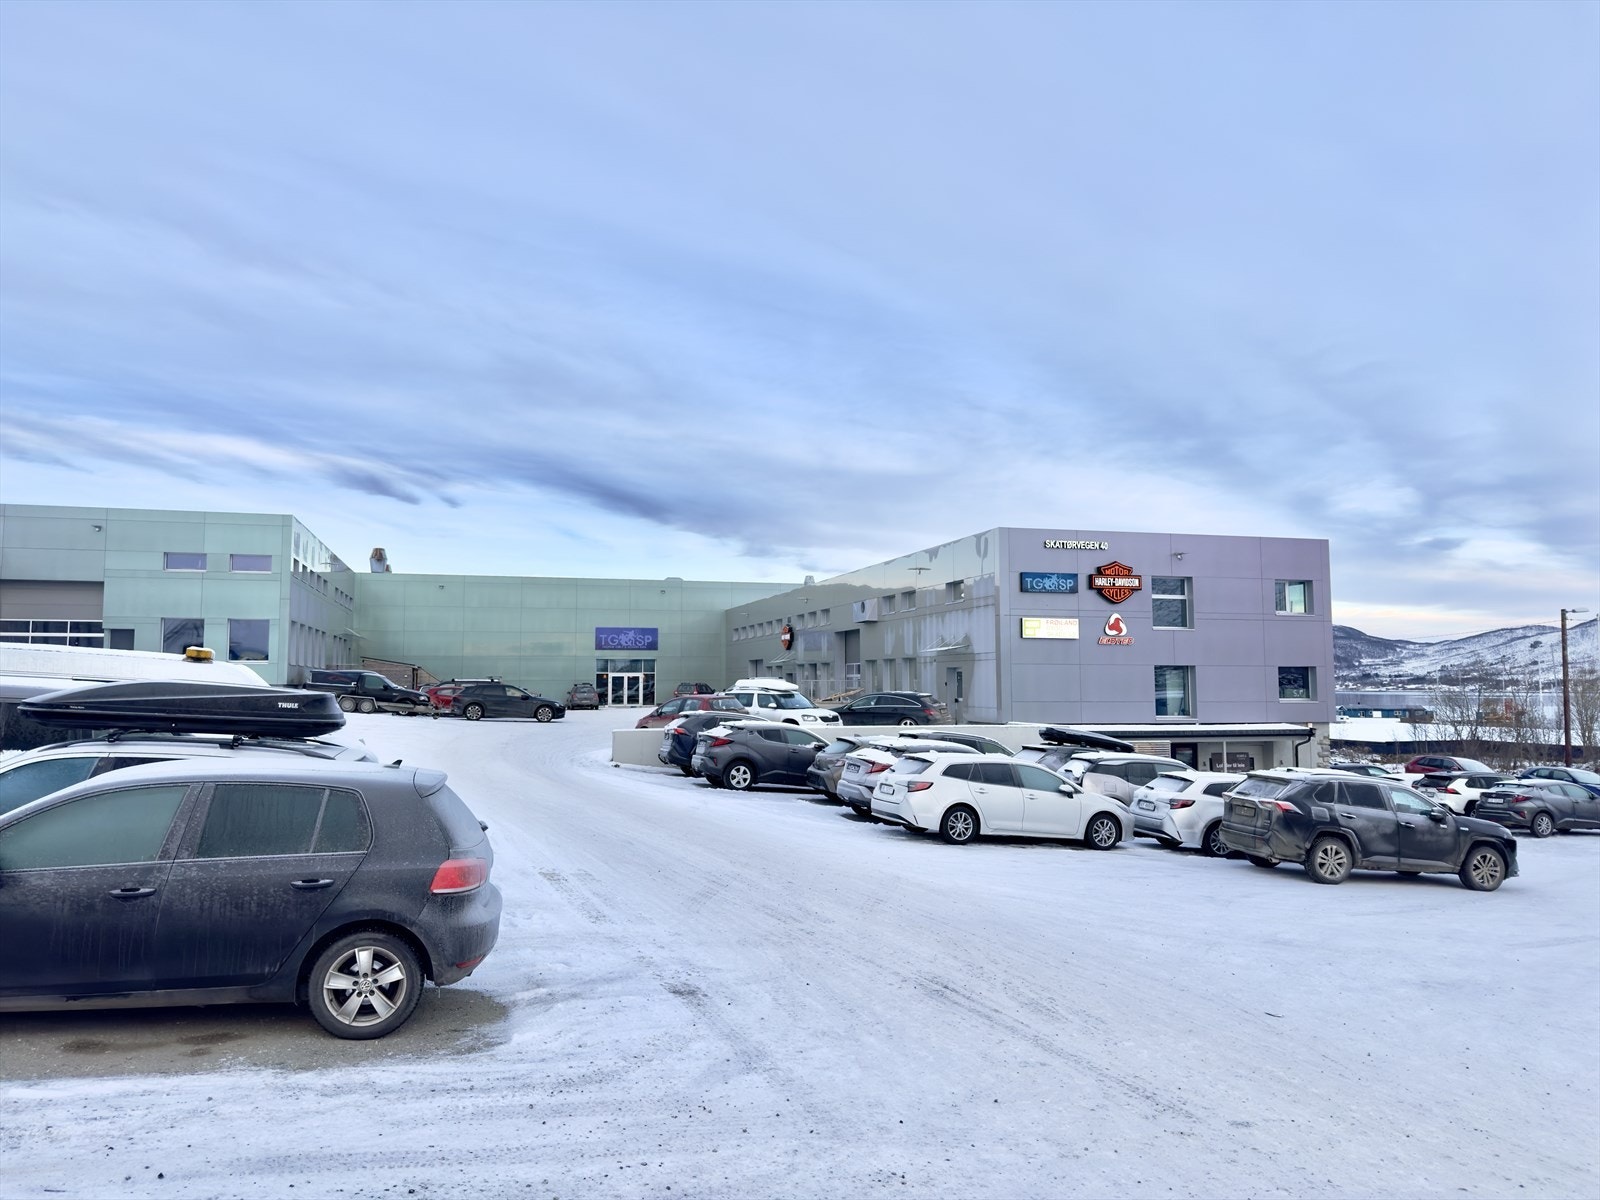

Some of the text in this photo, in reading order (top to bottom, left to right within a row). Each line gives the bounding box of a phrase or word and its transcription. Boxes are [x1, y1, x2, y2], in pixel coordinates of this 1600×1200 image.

[1044, 540, 1109, 550] SKATTØRVEGEN 40
[1104, 565, 1130, 576] MOTOR
[1094, 577, 1140, 587] HARLEY-DAVIDSON
[1104, 588, 1130, 600] CYCLES
